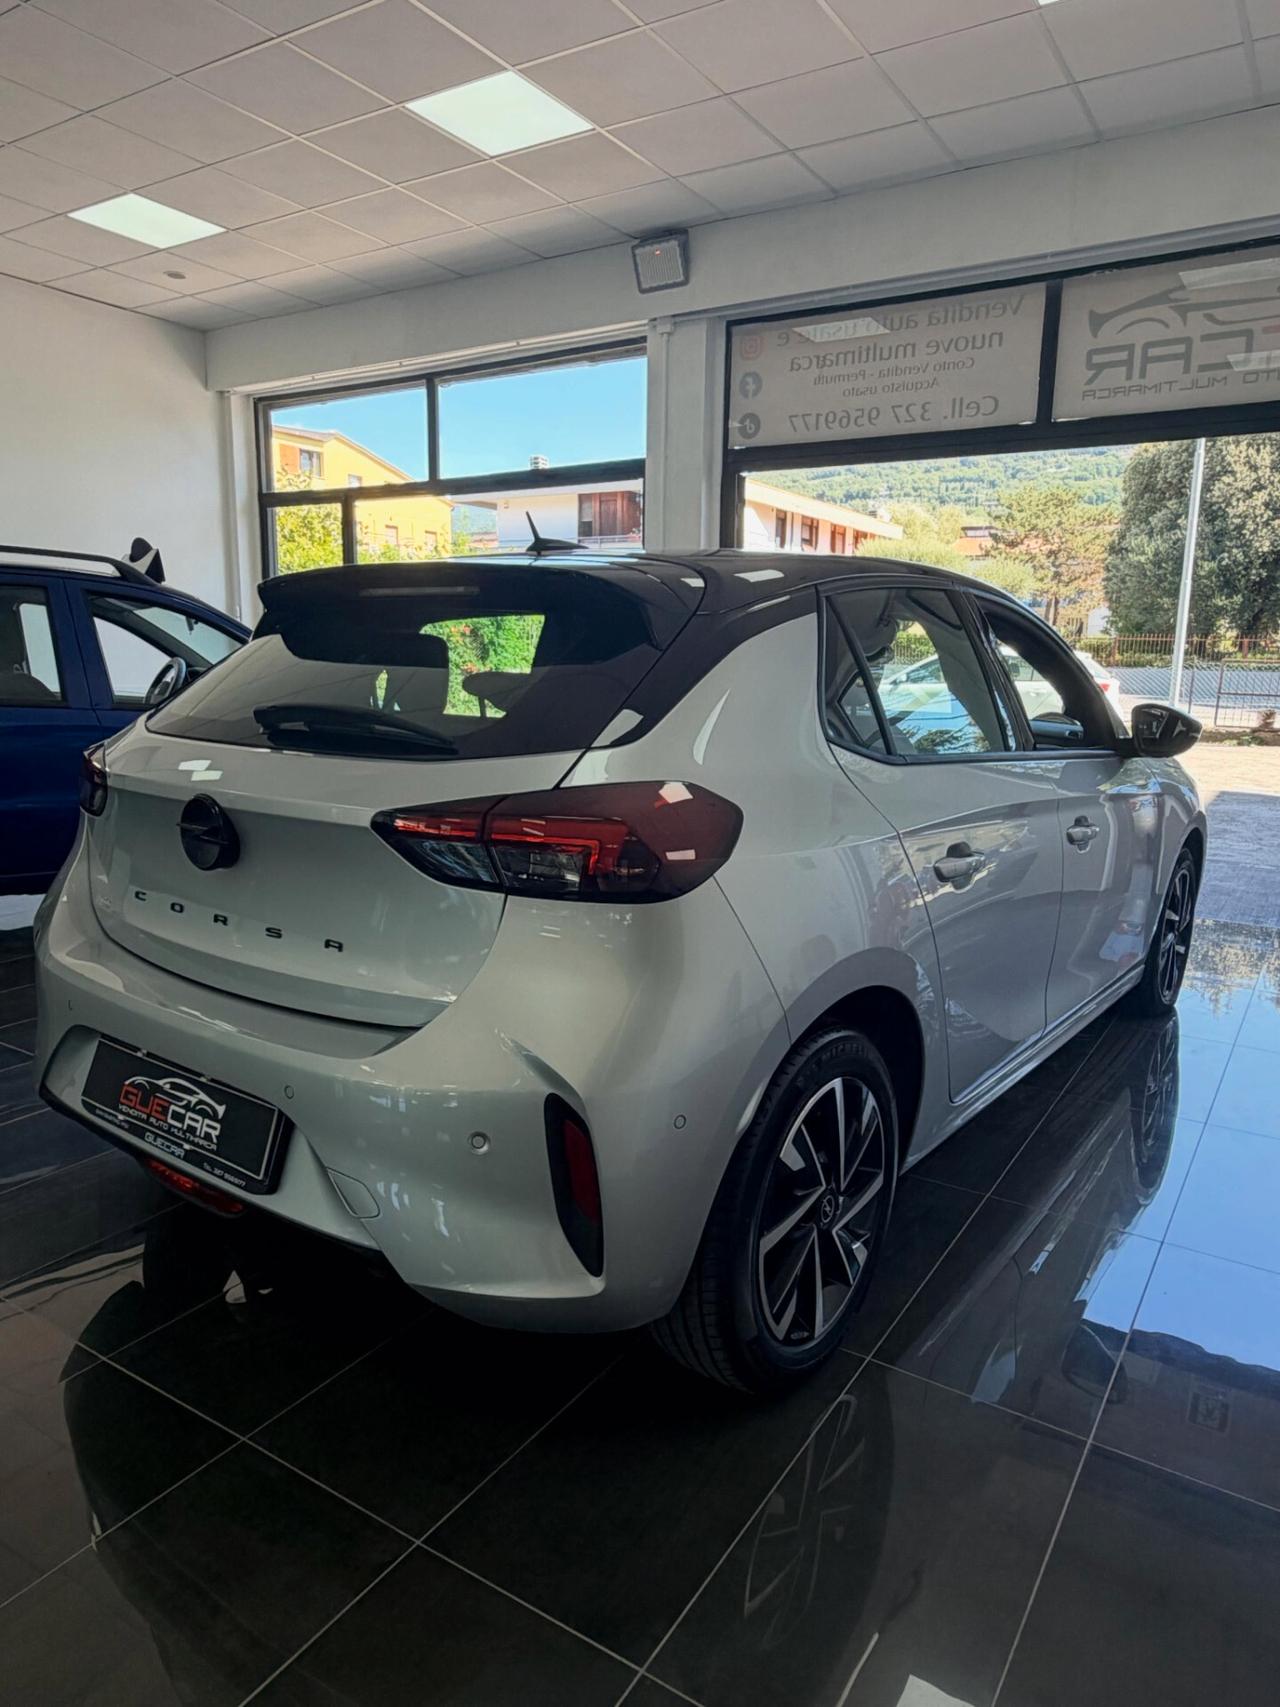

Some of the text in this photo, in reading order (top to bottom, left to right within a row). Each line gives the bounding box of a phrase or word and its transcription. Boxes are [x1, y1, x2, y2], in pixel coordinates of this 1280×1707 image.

[134, 890, 344, 953] CORSA
[120, 1084, 221, 1143] GUECAR
[148, 1117, 169, 1130] AUTO
[144, 1131, 185, 1159] GUECAR
